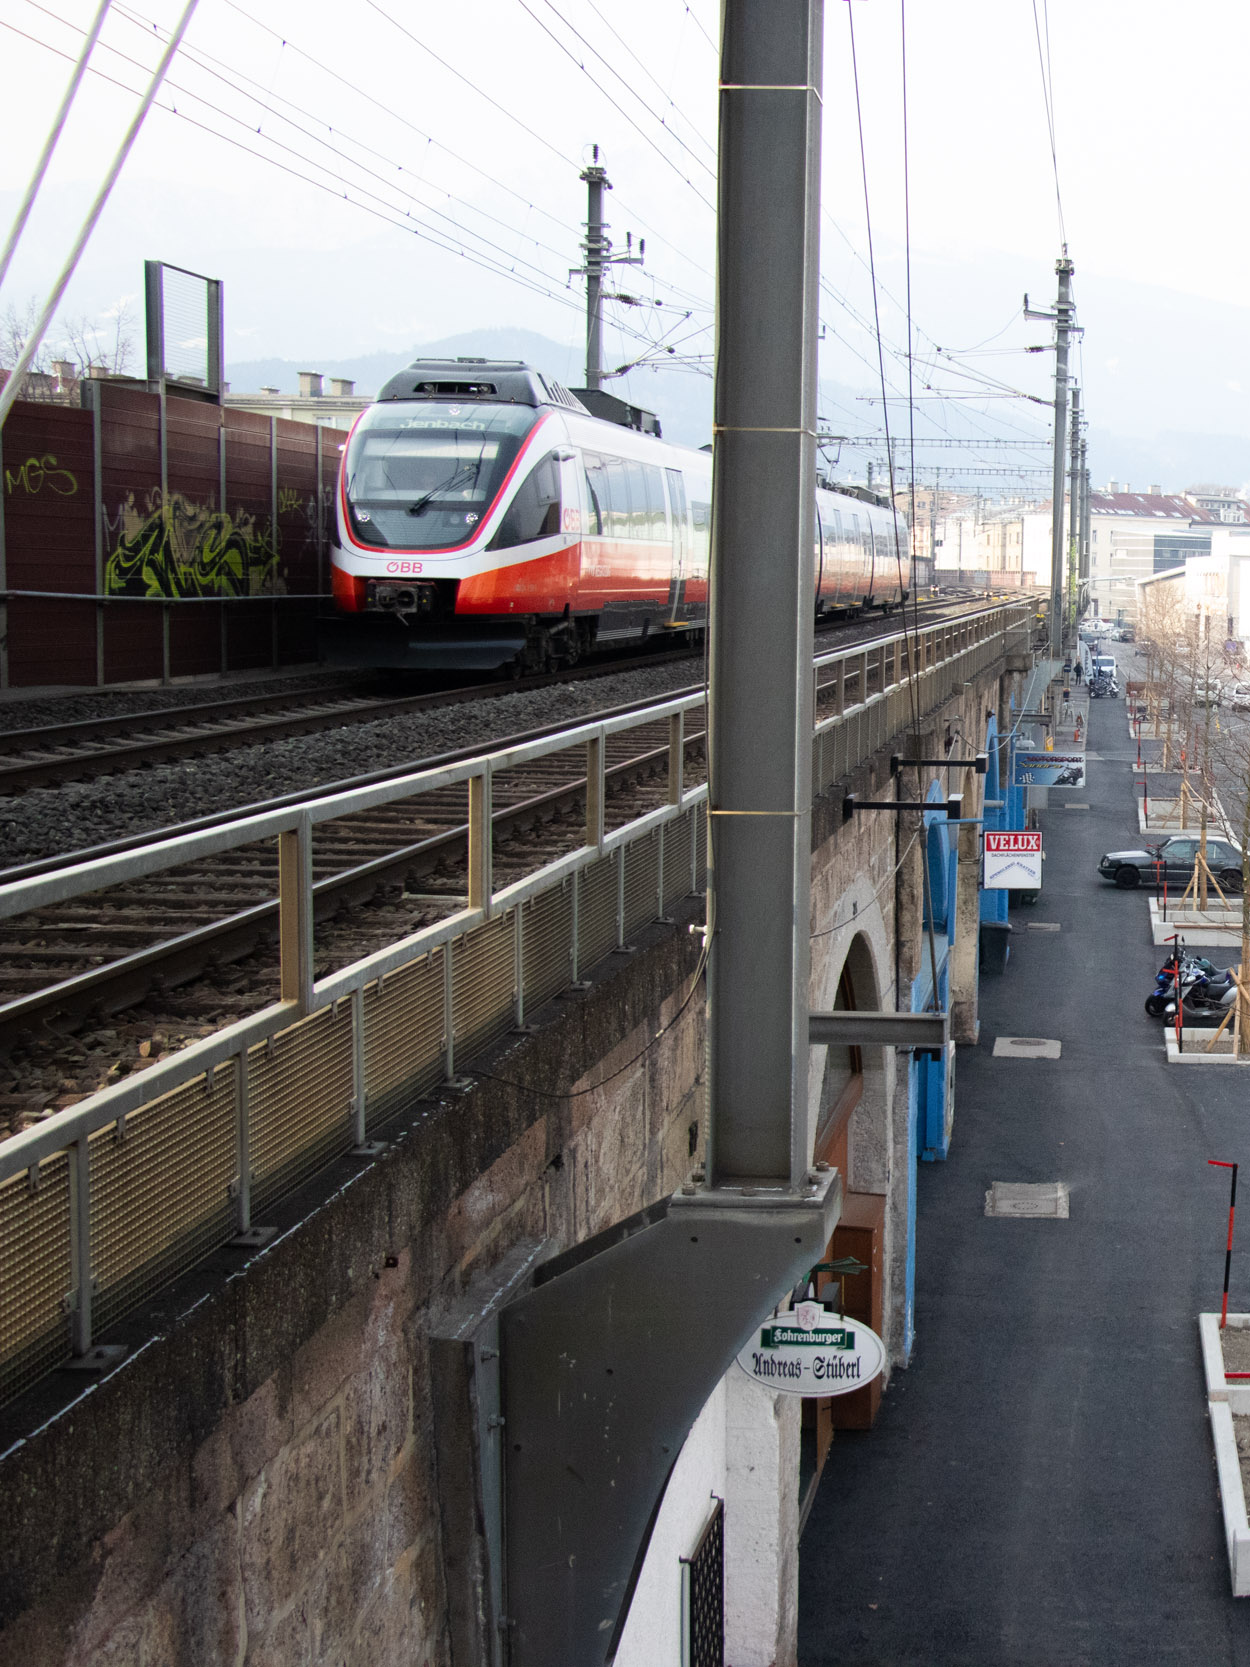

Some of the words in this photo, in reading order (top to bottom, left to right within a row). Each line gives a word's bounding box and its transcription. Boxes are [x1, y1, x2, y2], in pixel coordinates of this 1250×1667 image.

[401, 419, 485, 430] Jenbach
[989, 835, 1039, 849] VELUX
[774, 1329, 843, 1344] Fohrenburger
